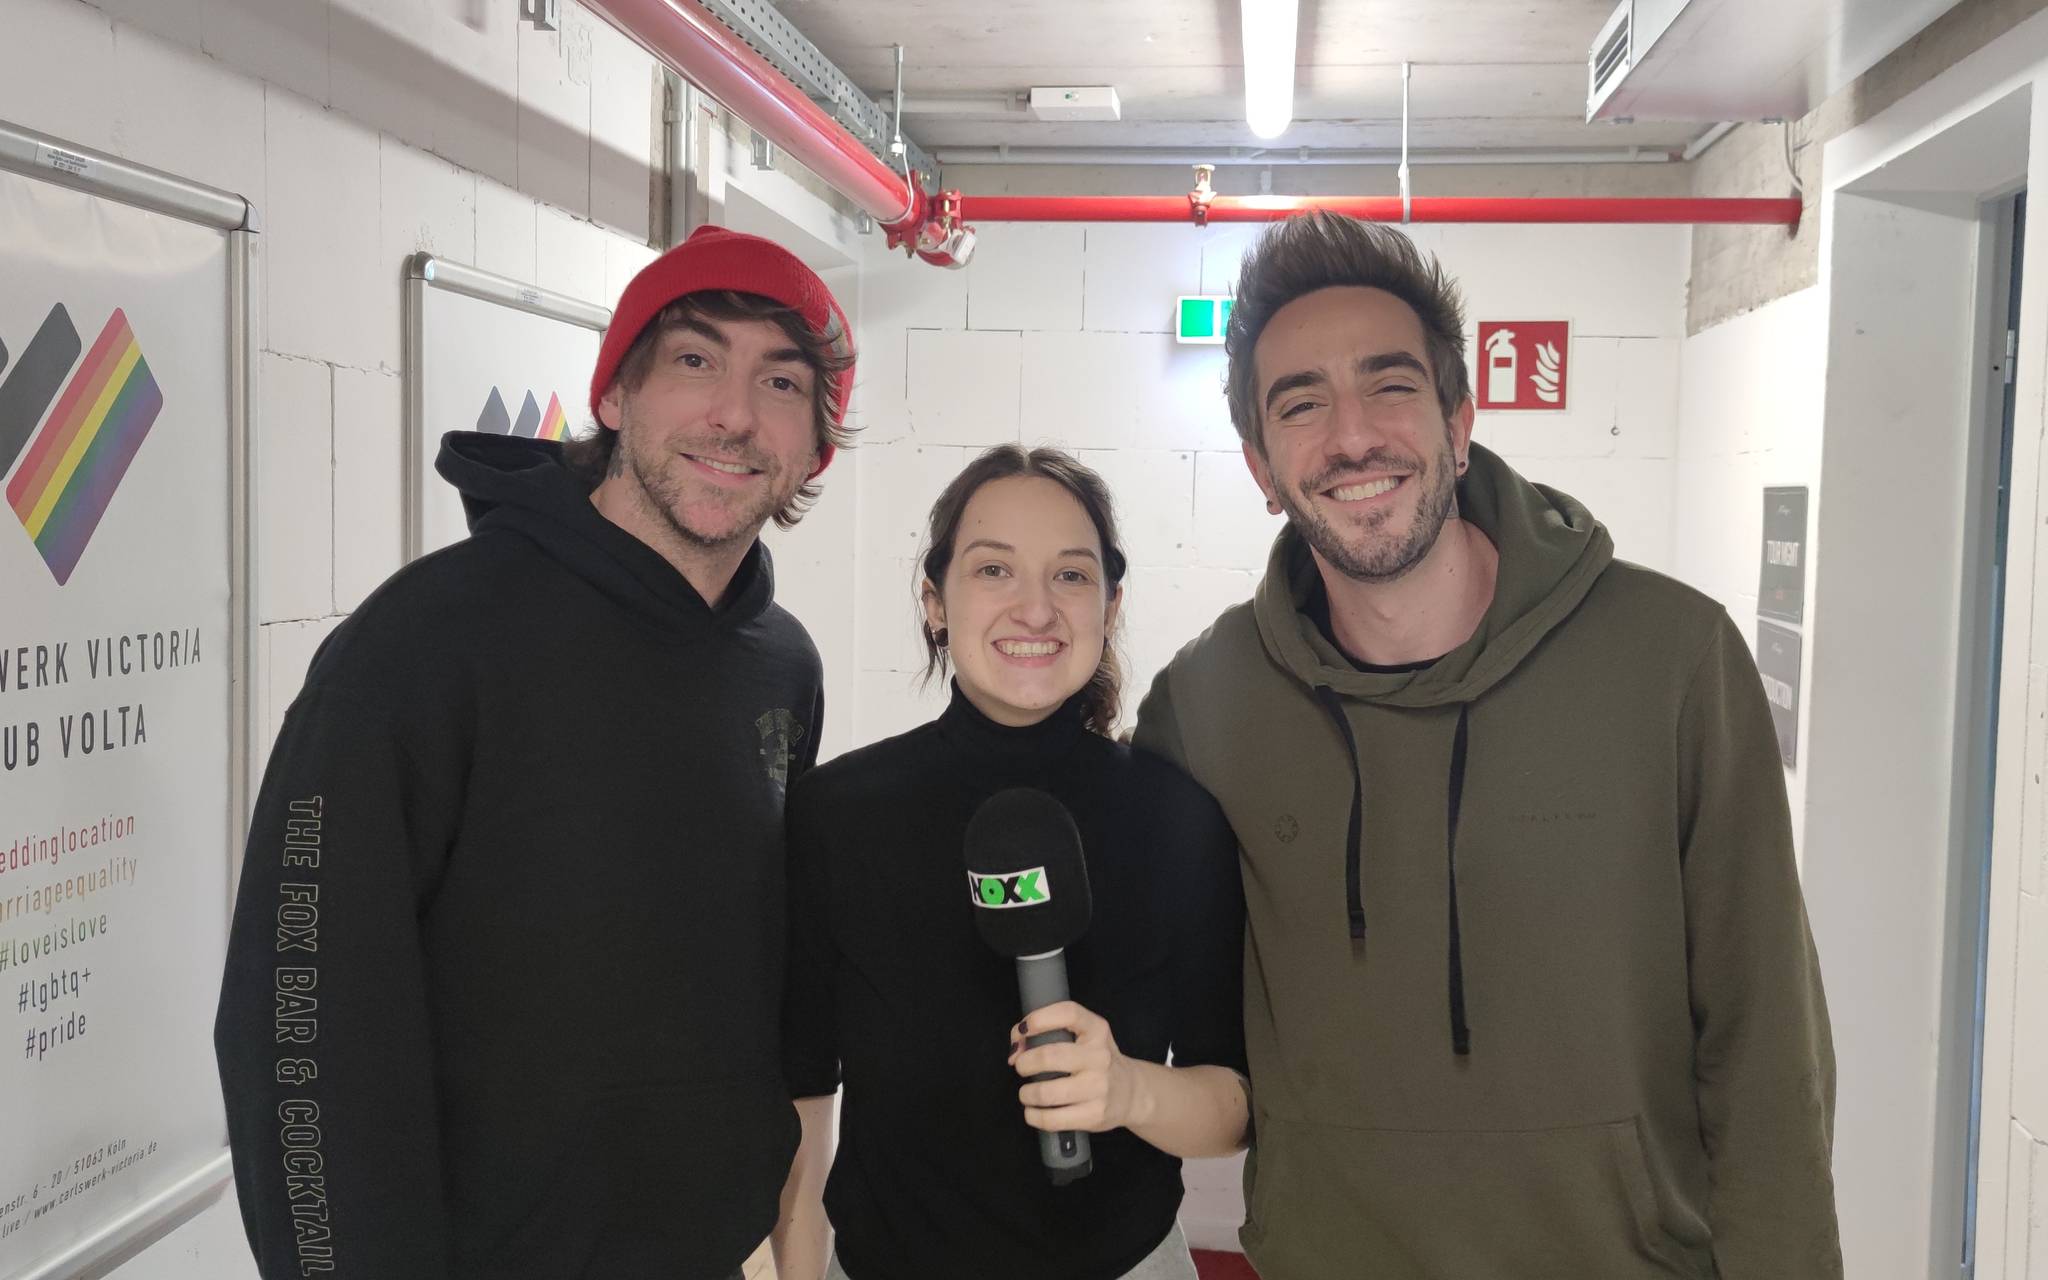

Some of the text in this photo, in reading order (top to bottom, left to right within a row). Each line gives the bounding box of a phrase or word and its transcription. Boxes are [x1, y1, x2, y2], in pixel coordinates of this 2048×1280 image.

[87, 627, 201, 680] VICTORIA
[4, 703, 147, 771] UB VOLTA
[0, 813, 135, 874] eddinglocation
[969, 870, 1046, 906] NOXX
[0, 913, 107, 973] #loveislove
[18, 967, 92, 1014] #lgbtq+
[25, 1011, 87, 1062] #pride
[275, 795, 335, 1277] THE FOX BAR & COCKTAIL
[32, 1183, 39, 1200] 6
[50, 1170, 63, 1189] 20
[74, 1147, 104, 1175] 51063
[107, 1138, 127, 1158] Köln
[34, 1140, 158, 1220] www.carlswerk-victoria.de
